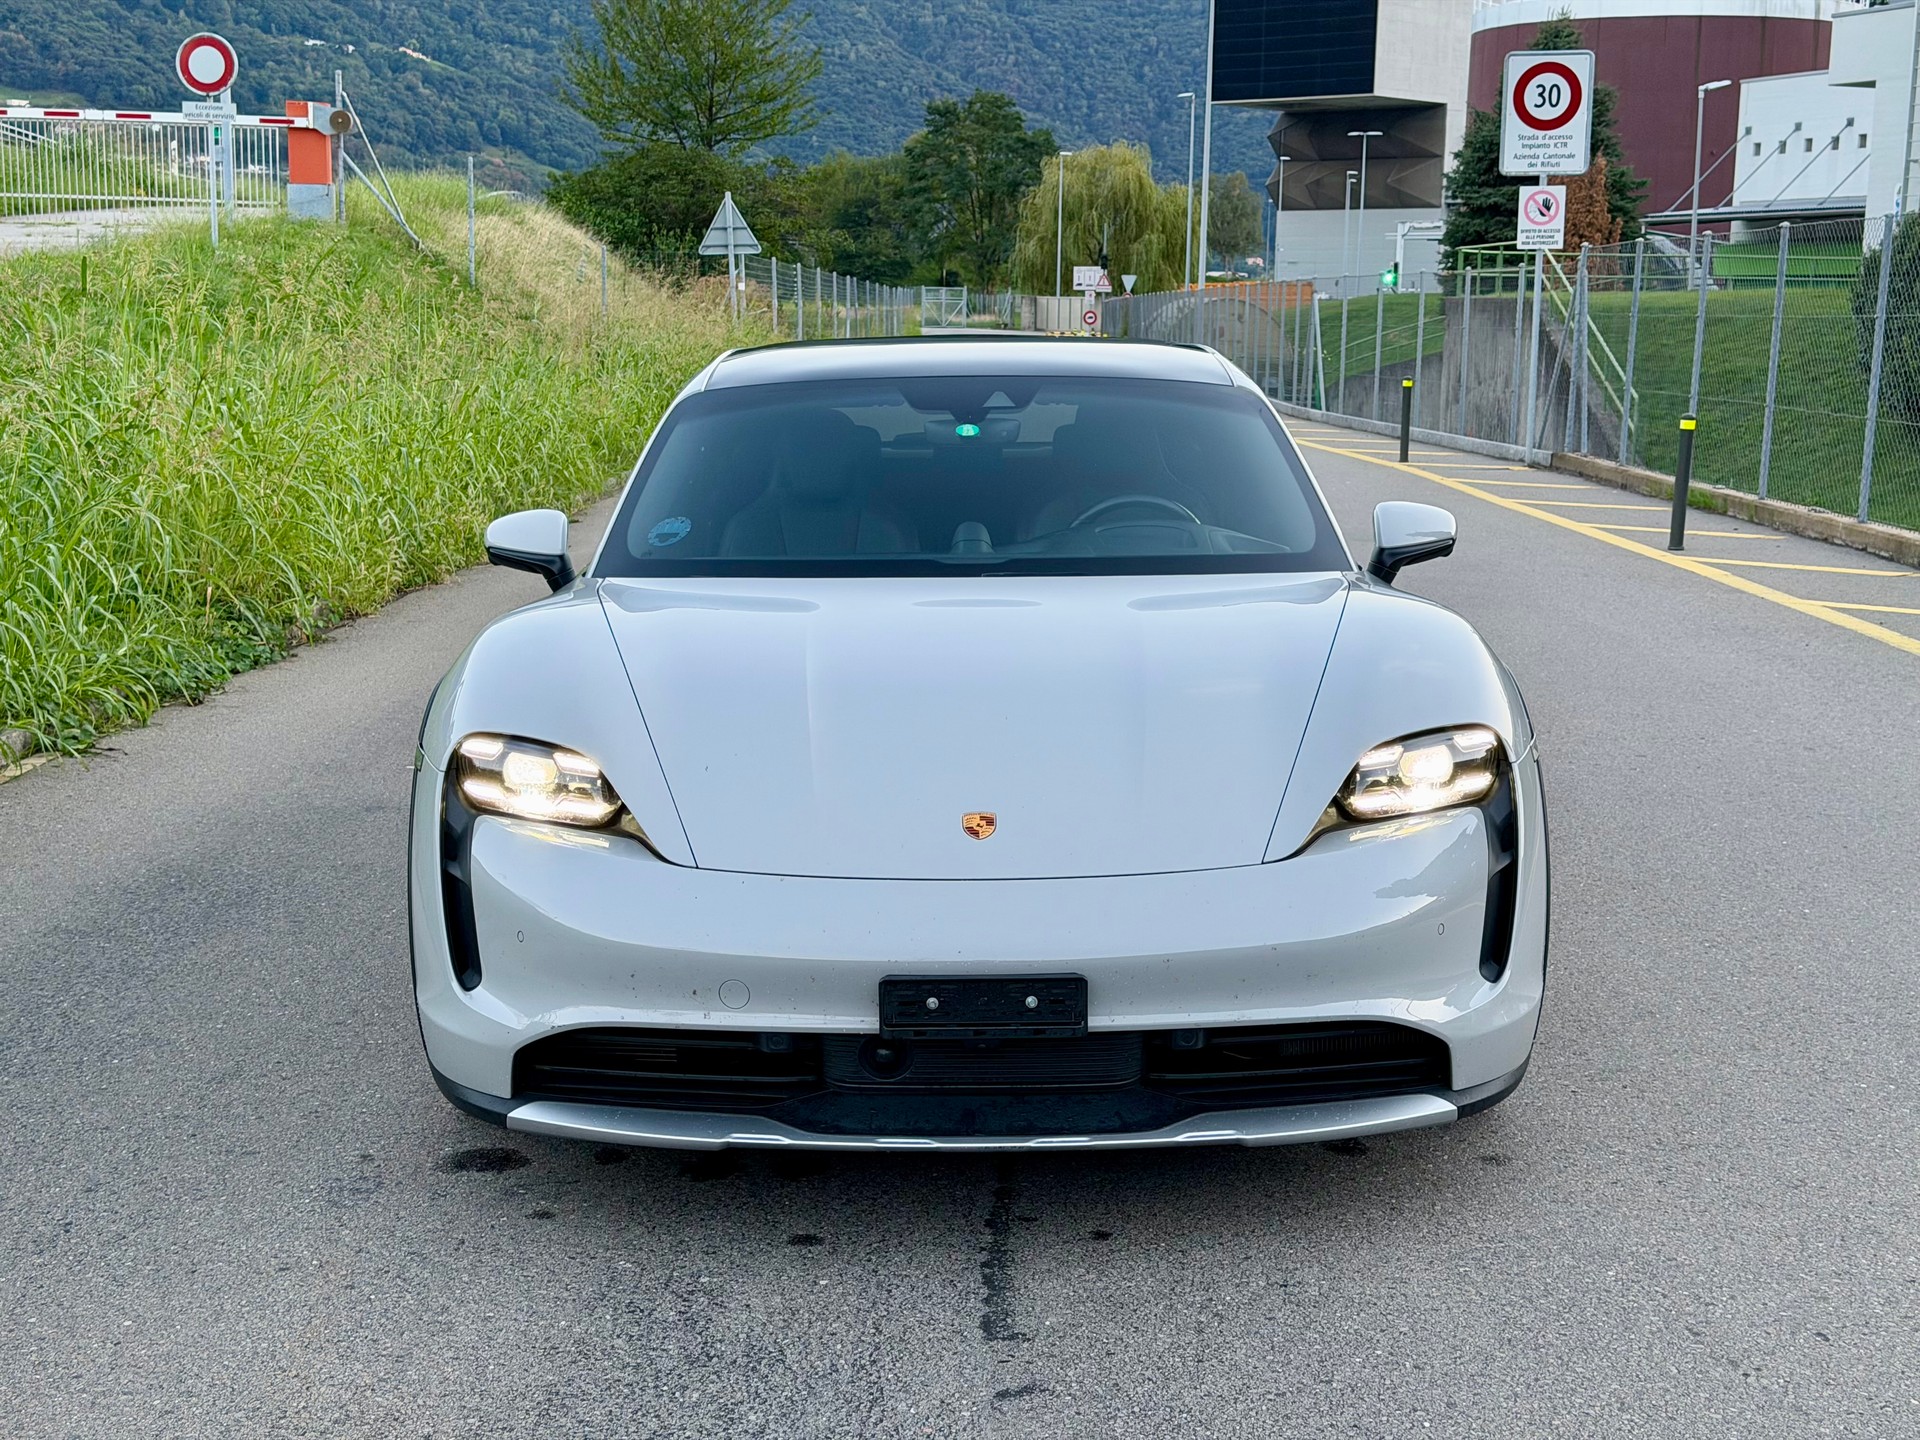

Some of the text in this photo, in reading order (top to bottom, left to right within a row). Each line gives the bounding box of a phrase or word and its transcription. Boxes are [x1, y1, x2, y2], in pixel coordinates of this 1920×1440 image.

[1533, 83, 1561, 108] 30
[1518, 133, 1573, 141] Strada d'accesso
[1521, 142, 1551, 150] Impianto
[1513, 152, 1576, 160] Azienda Cantonale
[1527, 160, 1560, 168] dei Rifiuti
